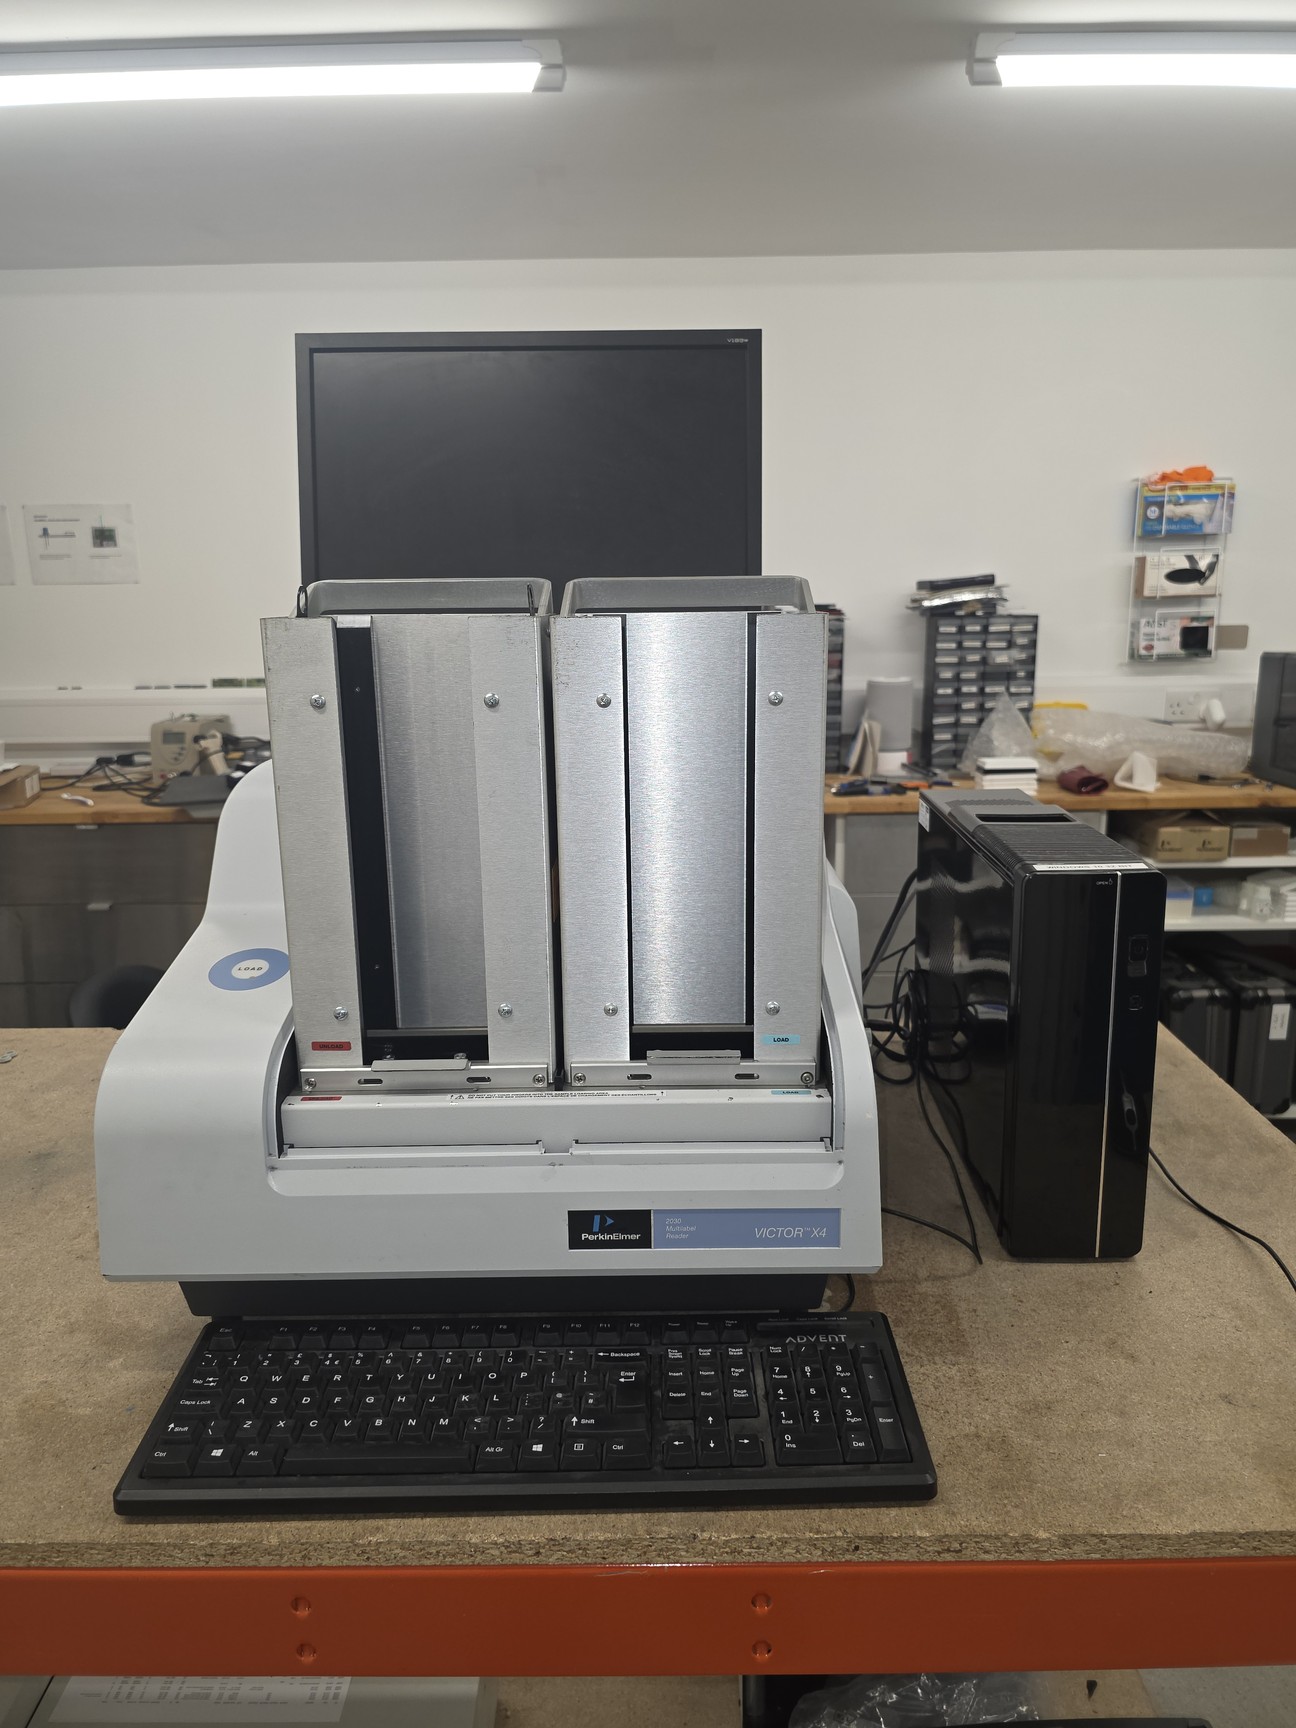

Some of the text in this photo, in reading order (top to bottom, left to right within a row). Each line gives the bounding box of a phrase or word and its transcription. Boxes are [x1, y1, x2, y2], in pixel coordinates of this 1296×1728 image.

[581, 1232, 641, 1241] PerkinElmer
[665, 1232, 689, 1240] Reader
[785, 1334, 847, 1343] ADVENT
